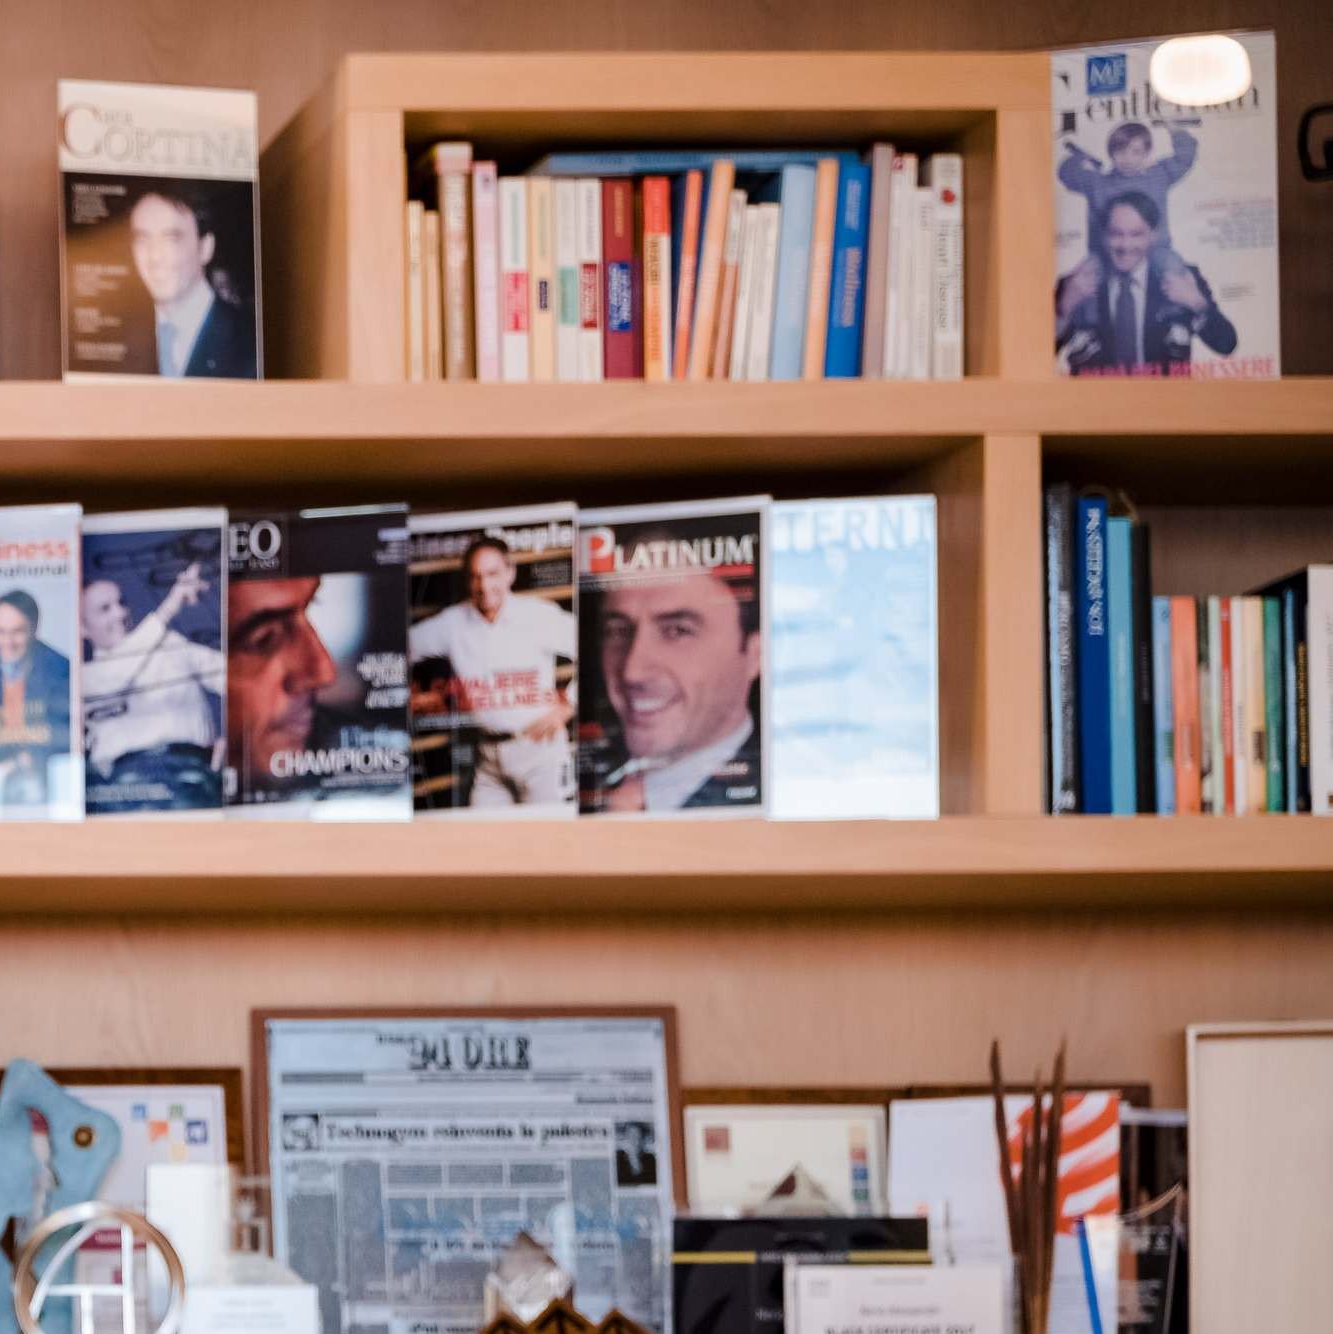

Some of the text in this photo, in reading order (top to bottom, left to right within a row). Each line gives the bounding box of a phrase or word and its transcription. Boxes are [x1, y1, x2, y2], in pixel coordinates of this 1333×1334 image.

[228, 520, 281, 561] EO
[587, 527, 756, 574] PLATINUM
[269, 748, 410, 778] CHAMPIONS
